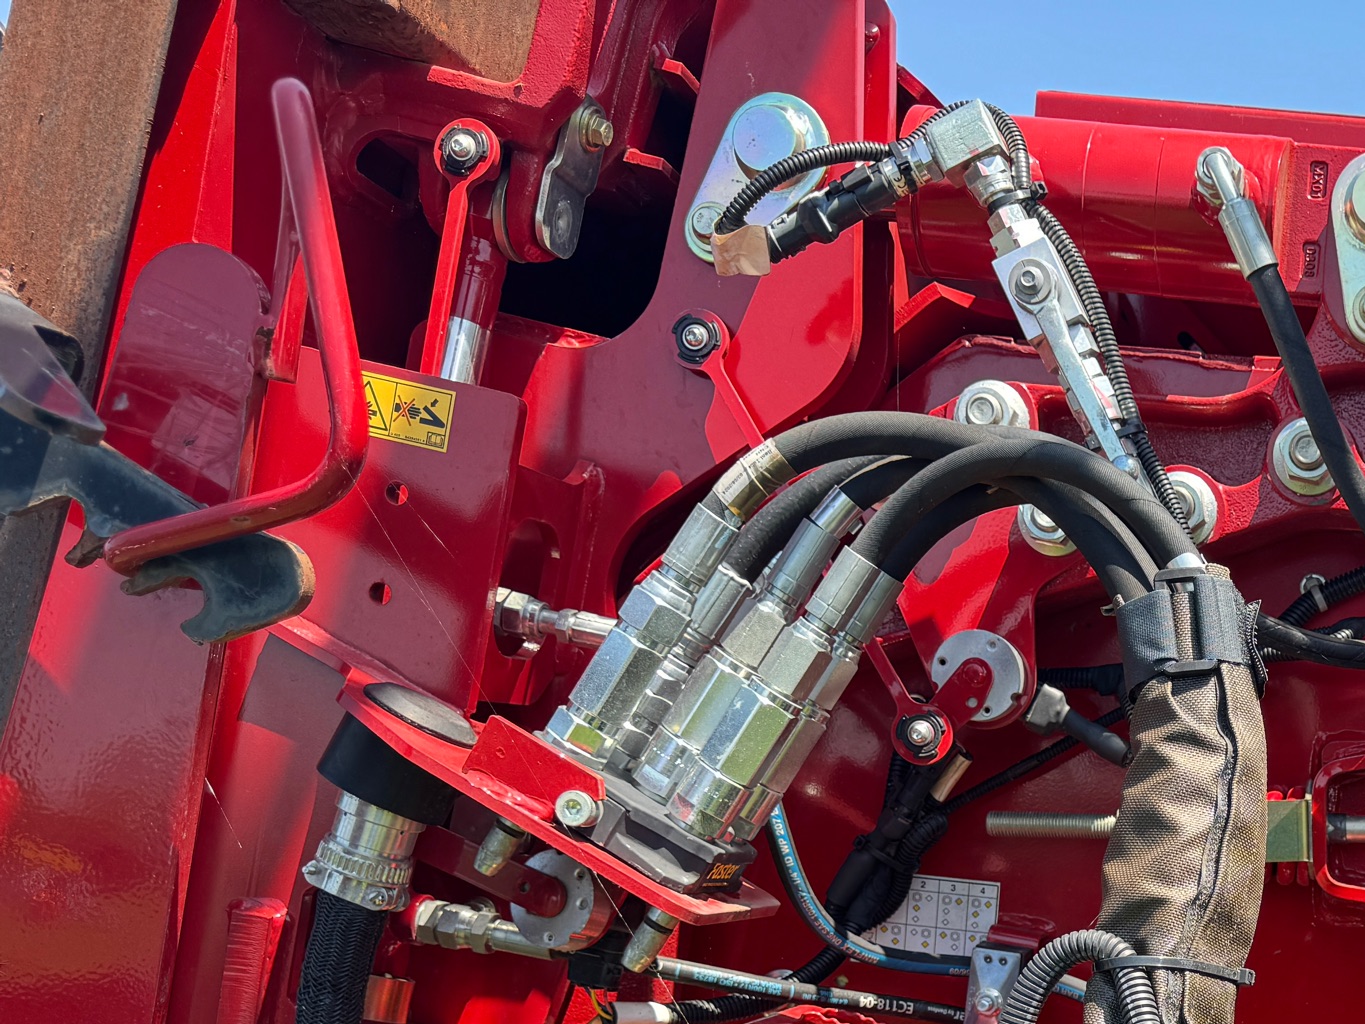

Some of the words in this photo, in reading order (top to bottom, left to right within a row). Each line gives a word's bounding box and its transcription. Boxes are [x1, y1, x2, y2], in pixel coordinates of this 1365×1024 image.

[777, 837, 790, 855] WP
[921, 881, 926, 889] 2
[951, 884, 956, 892] 3
[980, 887, 986, 895] 4
[858, 995, 914, 1015] EC118-04
